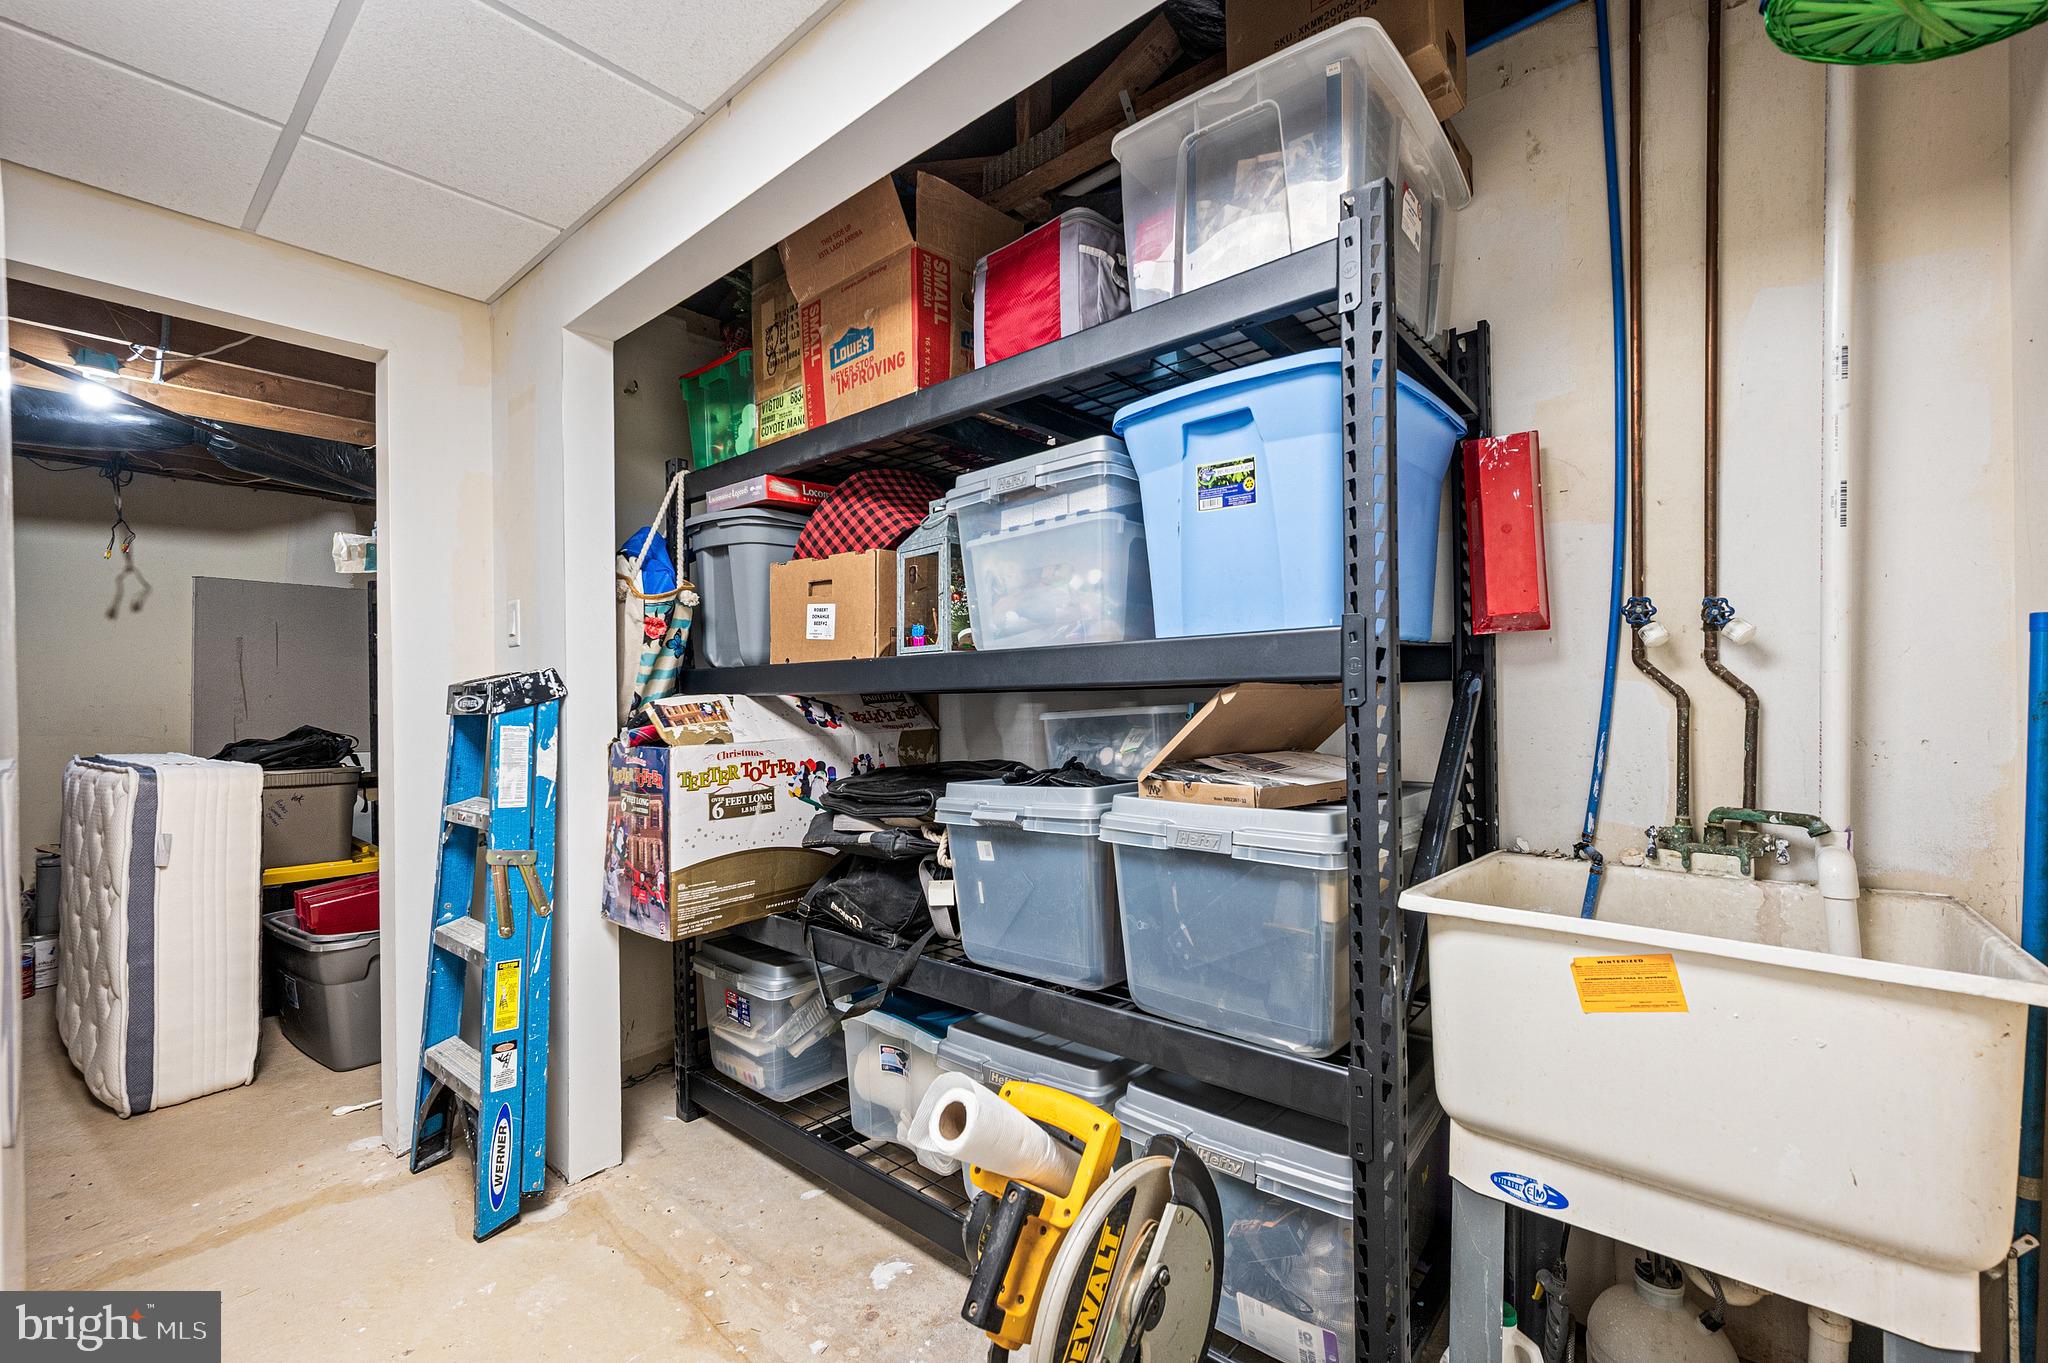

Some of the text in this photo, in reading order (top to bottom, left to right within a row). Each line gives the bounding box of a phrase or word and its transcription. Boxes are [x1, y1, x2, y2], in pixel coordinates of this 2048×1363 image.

[933, 258, 948, 325] SMALL
[809, 303, 821, 367] SMALL
[834, 335, 870, 364] LOWE'S
[831, 355, 874, 384] NEVER STOP
[836, 351, 905, 395] IMPROVING
[790, 390, 804, 405] 683
[761, 420, 785, 437] COYOTE
[716, 749, 764, 761] Christmas
[677, 758, 798, 791] TEETER TOTTER
[712, 801, 725, 820] 6
[725, 792, 773, 807] FEET LONG
[494, 1124, 509, 1187] WERNER
[1200, 1149, 1241, 1174] Hefty
[1067, 1225, 1120, 1363] EWALT
